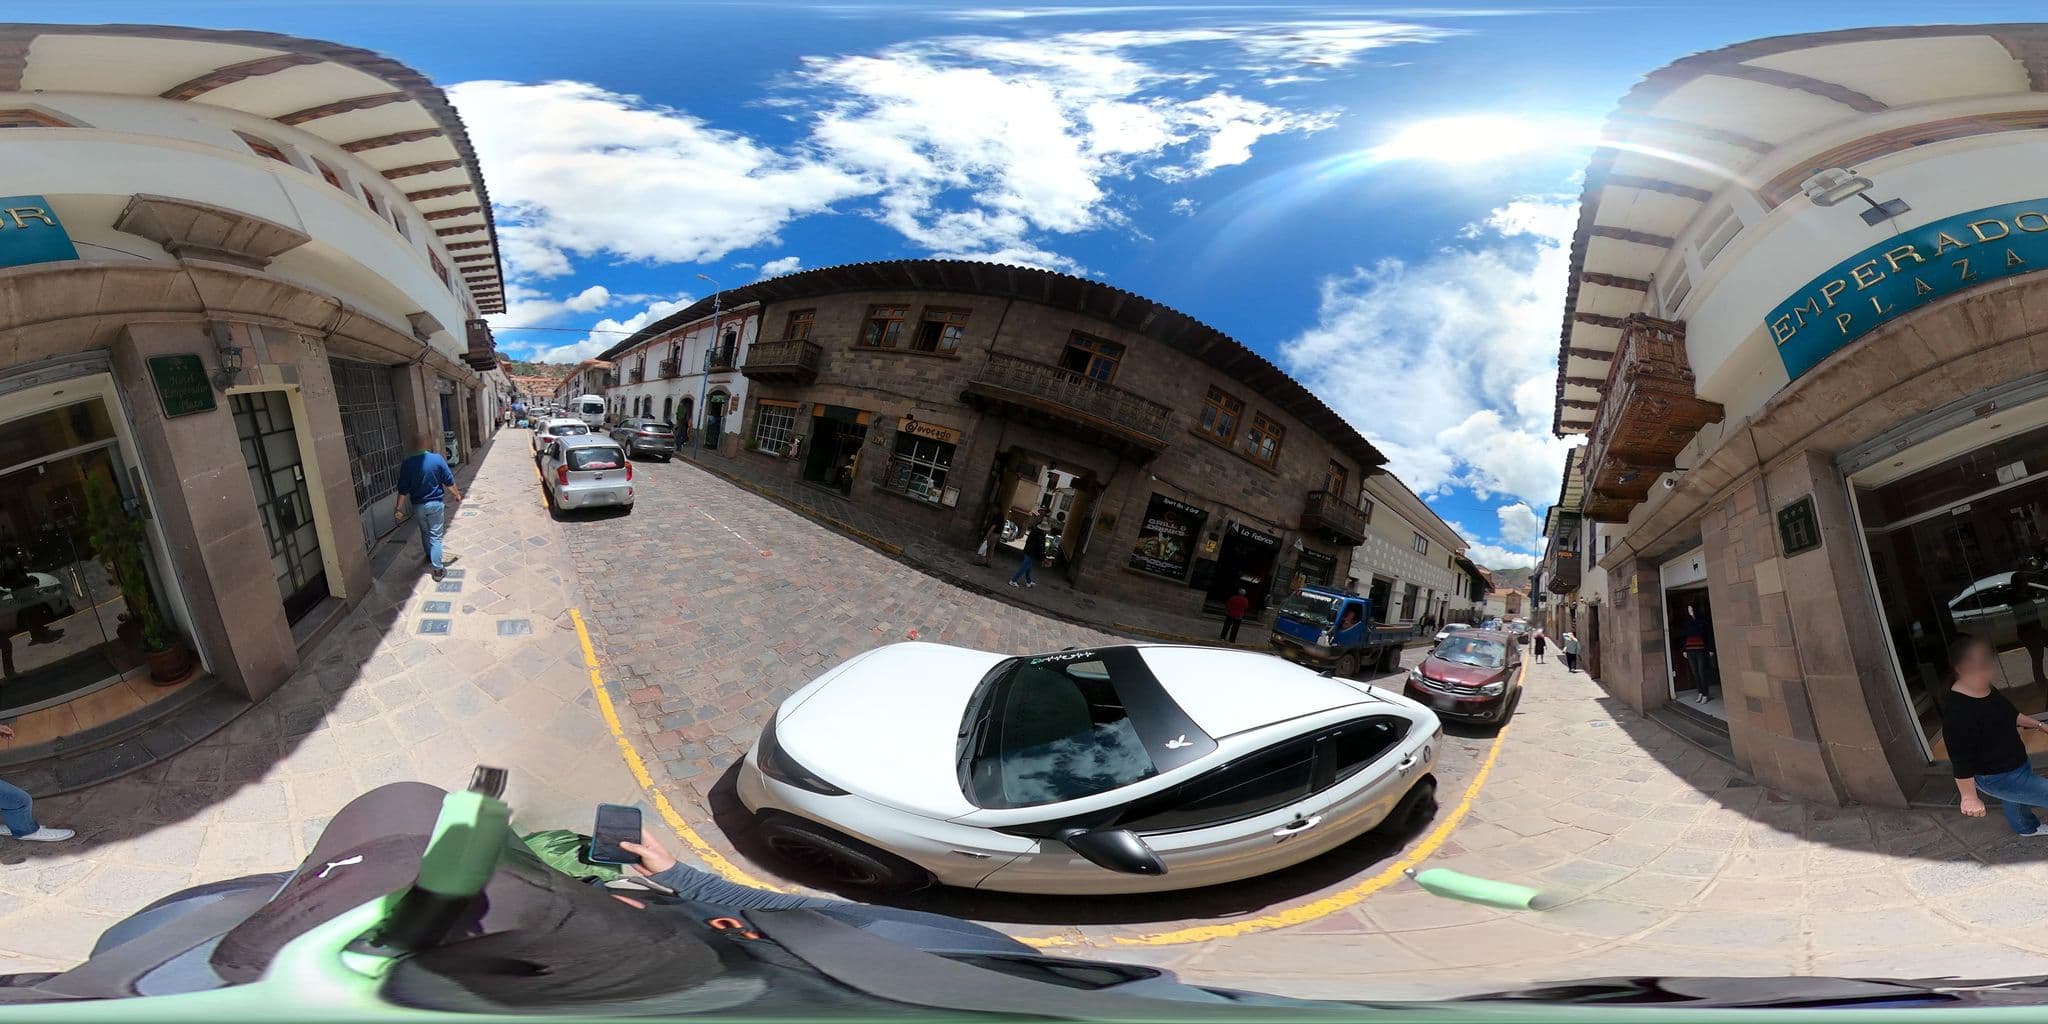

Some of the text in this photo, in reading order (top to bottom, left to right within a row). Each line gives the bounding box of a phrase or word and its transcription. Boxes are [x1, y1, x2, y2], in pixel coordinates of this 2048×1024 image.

[1771, 212, 2048, 346] EMPERADO
[1835, 248, 2026, 334] PLAZA
[917, 425, 951, 439] avocado
[1148, 518, 1177, 530] GRILL
[1240, 529, 1250, 537] La
